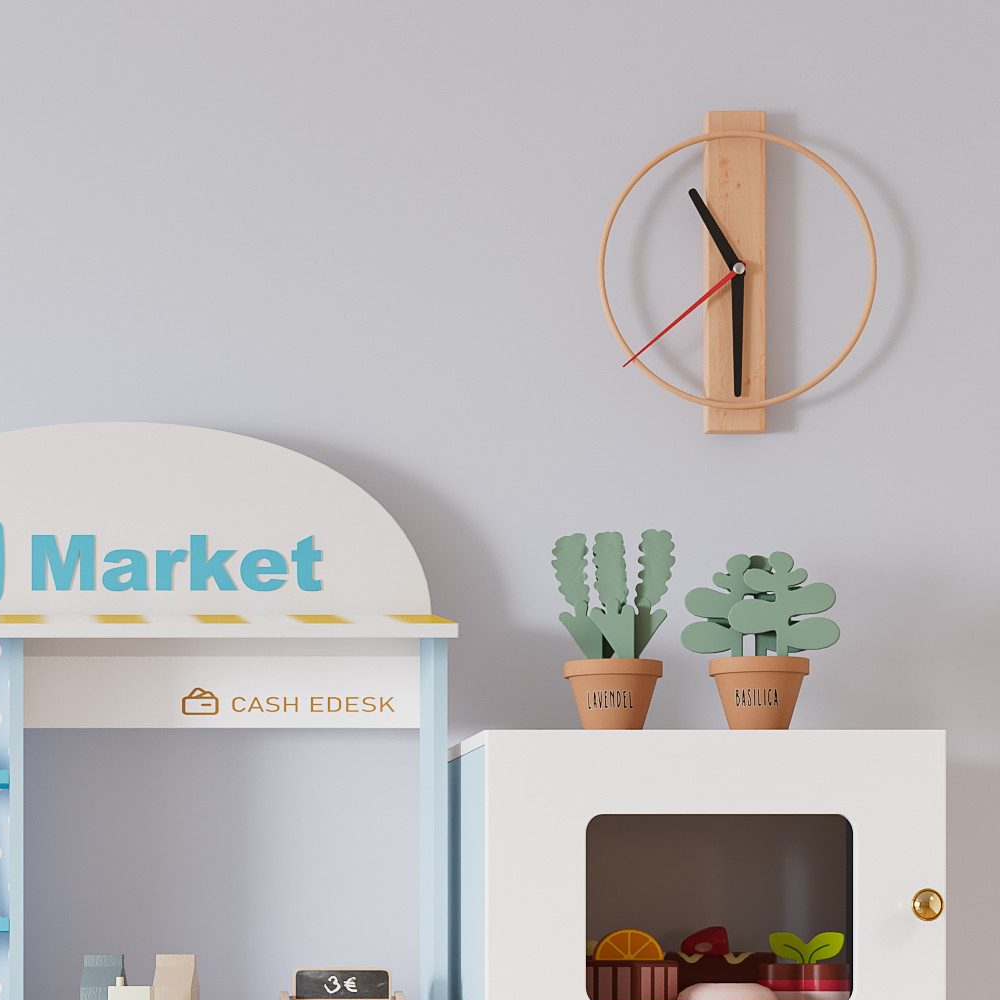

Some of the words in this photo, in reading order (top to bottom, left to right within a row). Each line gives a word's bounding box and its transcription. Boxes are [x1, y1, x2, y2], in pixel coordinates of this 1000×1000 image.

[31, 534, 324, 592] Market
[231, 696, 299, 713] CASH
[310, 696, 395, 713] EDESK
[587, 690, 634, 709] LAVENDEL
[735, 689, 779, 707] BASILICA
